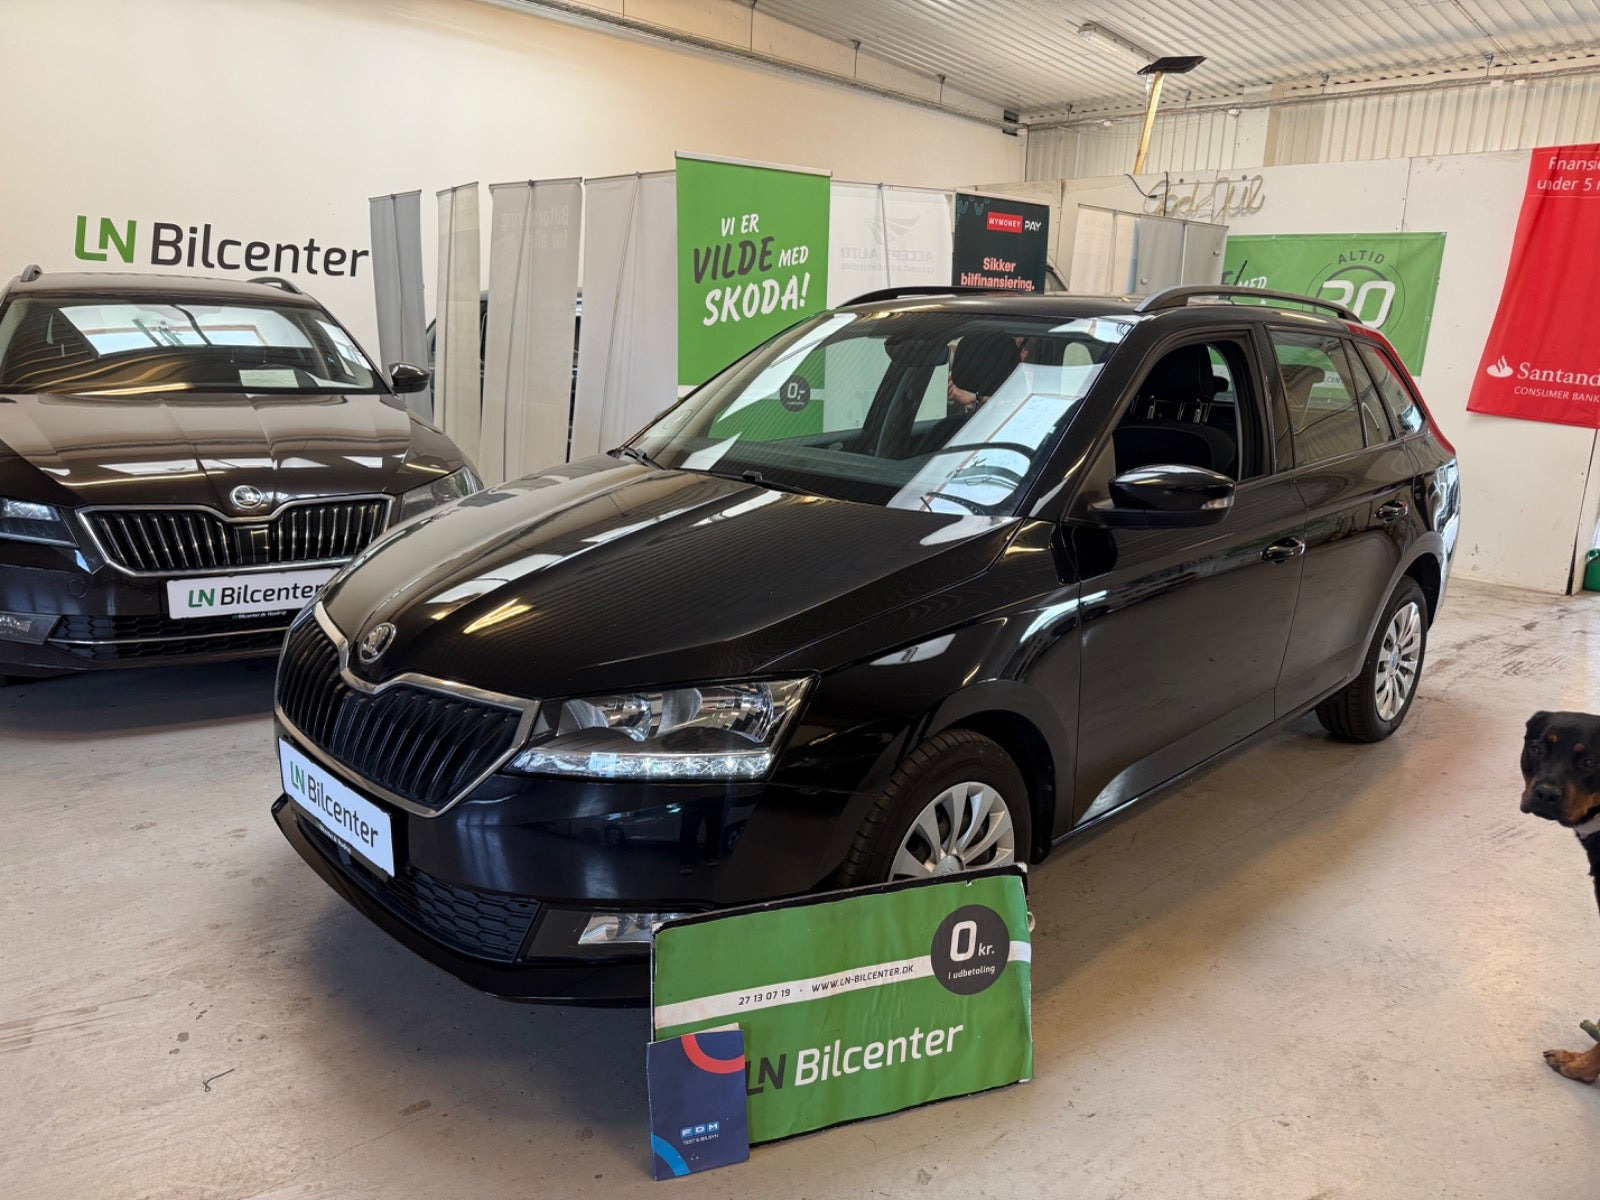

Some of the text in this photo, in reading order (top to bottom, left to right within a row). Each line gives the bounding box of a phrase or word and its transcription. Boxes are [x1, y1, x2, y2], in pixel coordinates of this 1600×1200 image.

[1583, 177, 1593, 191] 5
[721, 213, 759, 237] VI ER
[988, 217, 1042, 232] MYMONEY PAY
[75, 215, 369, 277] LN Bilcenter
[1337, 250, 1385, 265] ALTID
[693, 235, 809, 284] VILDE MED
[983, 257, 1017, 272] Sikker
[961, 272, 1036, 292] bilfinansiering.
[703, 272, 811, 327] SKODA!
[1514, 386, 1600, 403] CONSUMER BANK
[188, 583, 325, 608] LN Bilcenter
[290, 761, 305, 795] LN
[307, 774, 378, 848] Bilcenter
[950, 920, 995, 962] 0 kr.
[953, 965, 996, 979] udbetaling
[738, 996, 750, 1006] 27
[754, 994, 763, 1002] 13
[766, 991, 778, 1000] 07
[781, 988, 791, 997] 19
[811, 965, 914, 993] WWW.LN-BILCENTER.DK
[794, 1024, 964, 1086] Bilcenter
[681, 1123, 718, 1137] FDM
